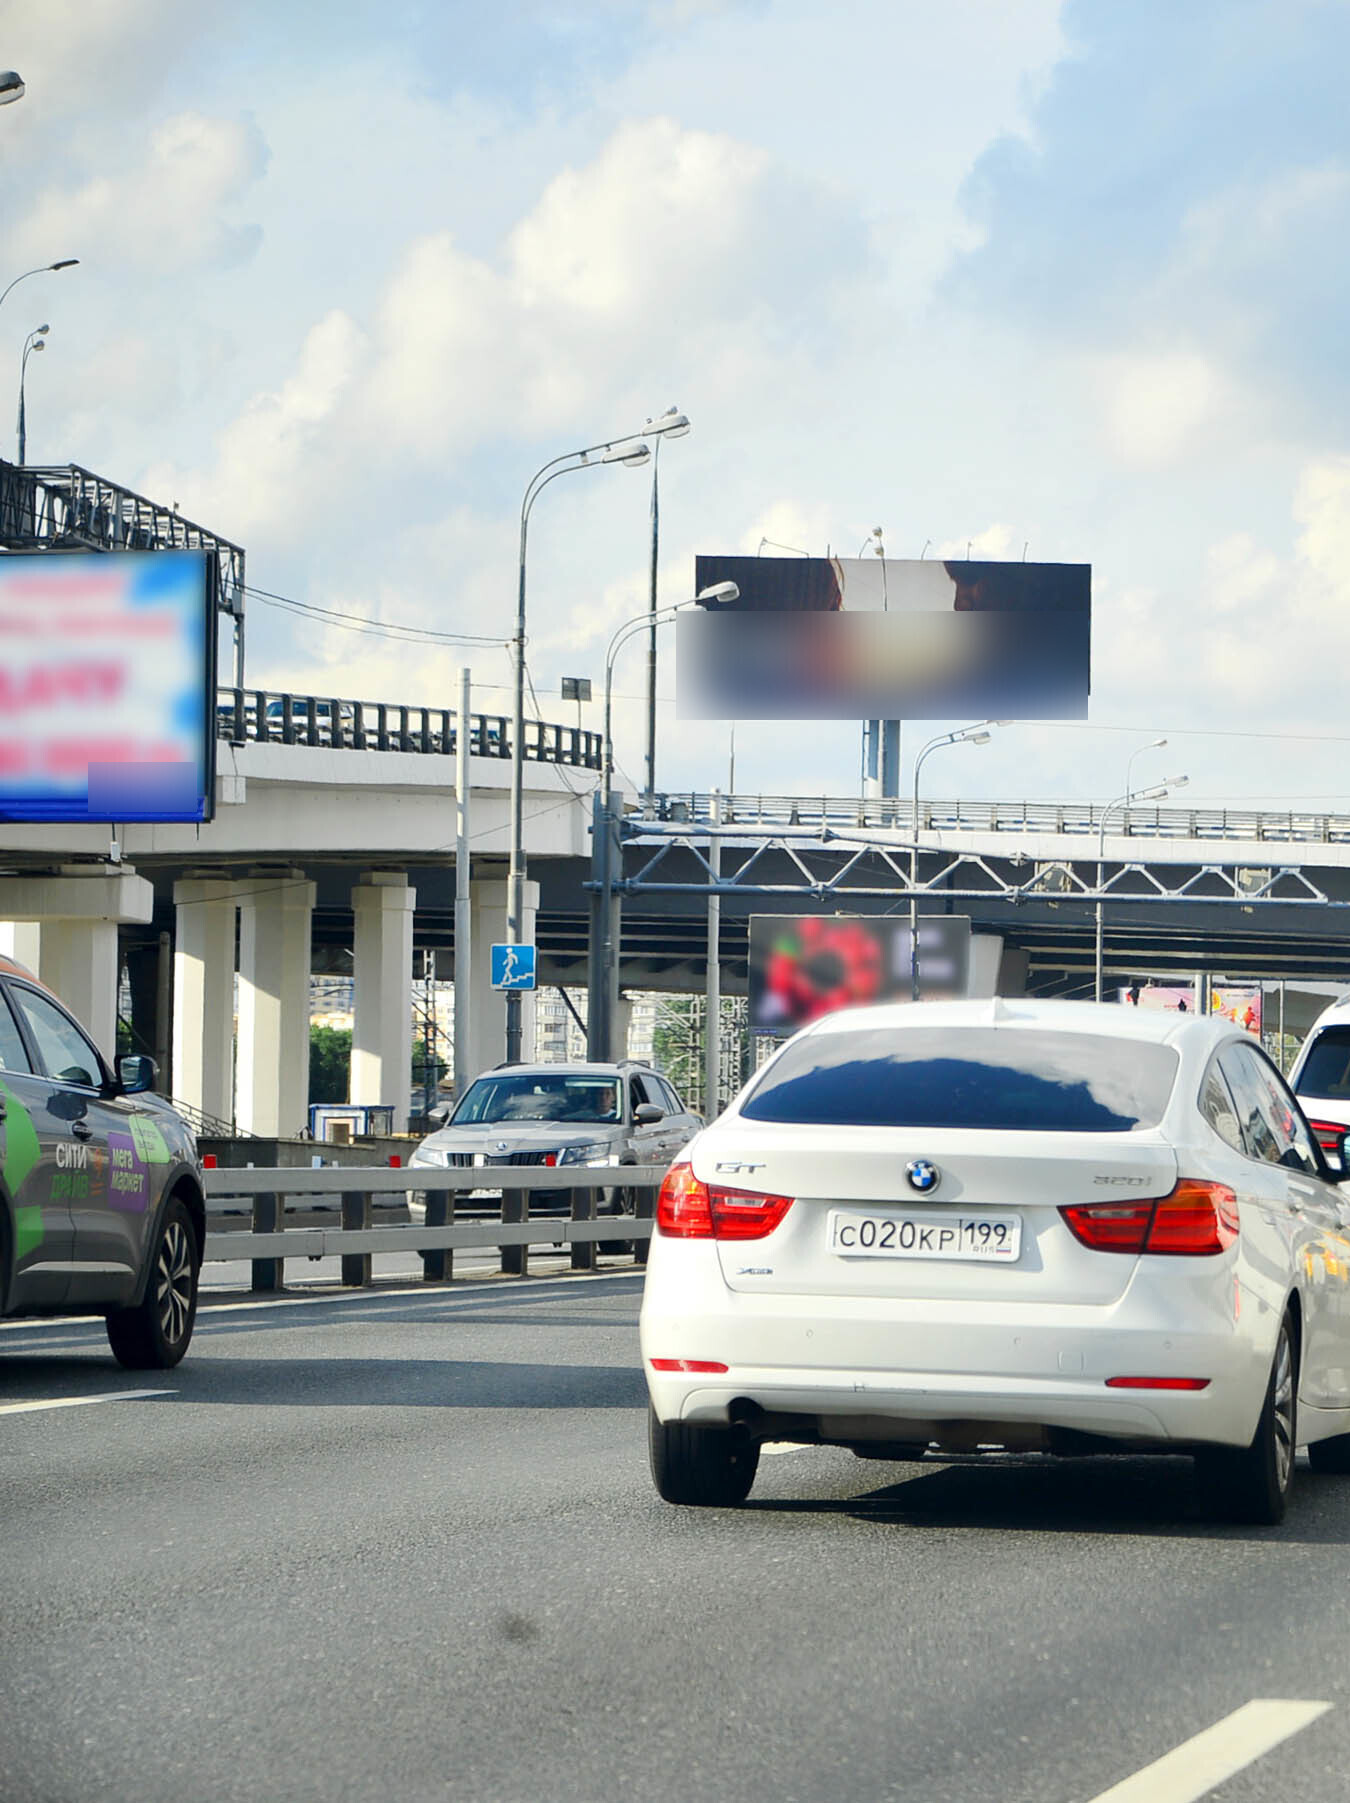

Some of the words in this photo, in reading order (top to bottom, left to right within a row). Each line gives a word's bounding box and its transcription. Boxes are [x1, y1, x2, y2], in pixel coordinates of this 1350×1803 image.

[56, 1143, 88, 1169] СИТИ
[715, 1162, 767, 1174] GT
[840, 1220, 954, 1251] С020КР
[965, 1222, 1008, 1246] 199
